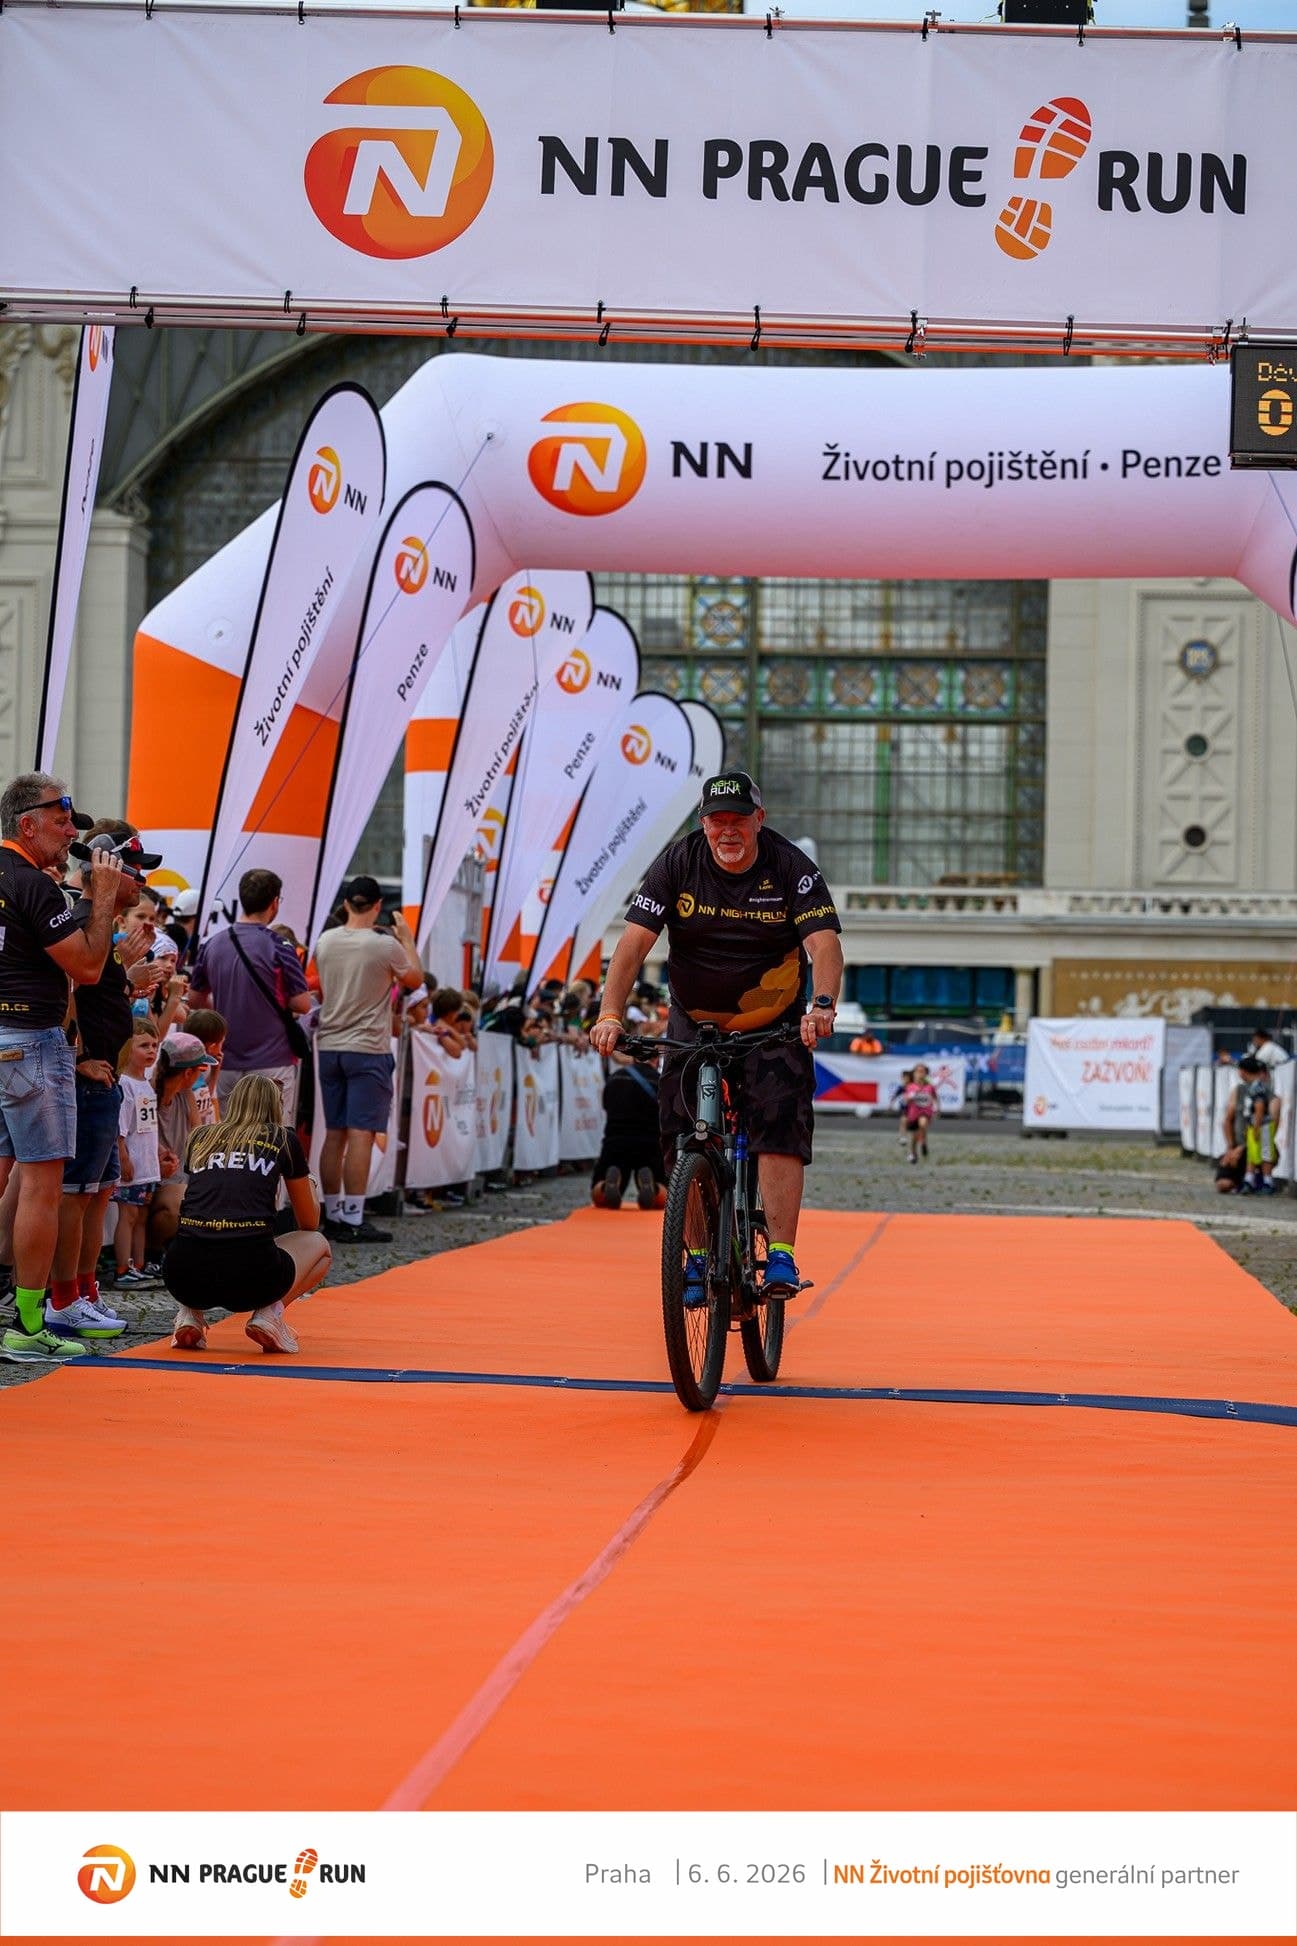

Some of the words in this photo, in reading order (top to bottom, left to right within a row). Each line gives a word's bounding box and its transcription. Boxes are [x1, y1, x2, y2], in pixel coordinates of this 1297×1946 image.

[538, 135, 669, 198] NN
[702, 138, 989, 208] PRAGUE
[1097, 150, 1247, 215] RUN
[670, 440, 753, 479] NN
[821, 442, 937, 482] Životní
[945, 449, 1091, 489] pojištění
[1121, 449, 1222, 479] Penze
[344, 484, 368, 515] NN
[432, 566, 457, 593] NN
[550, 612, 576, 635] NN
[254, 661, 294, 747] Životní
[292, 566, 334, 670] pojištění
[397, 643, 429, 702] Penze
[596, 670, 622, 691] NN
[564, 731, 596, 779] Penze
[464, 751, 502, 818] Životní
[710, 787, 735, 797] RUN
[632, 893, 666, 917] REW
[698, 905, 716, 916] NN
[720, 907, 756, 920] NIGHT
[762, 911, 787, 921] RUN
